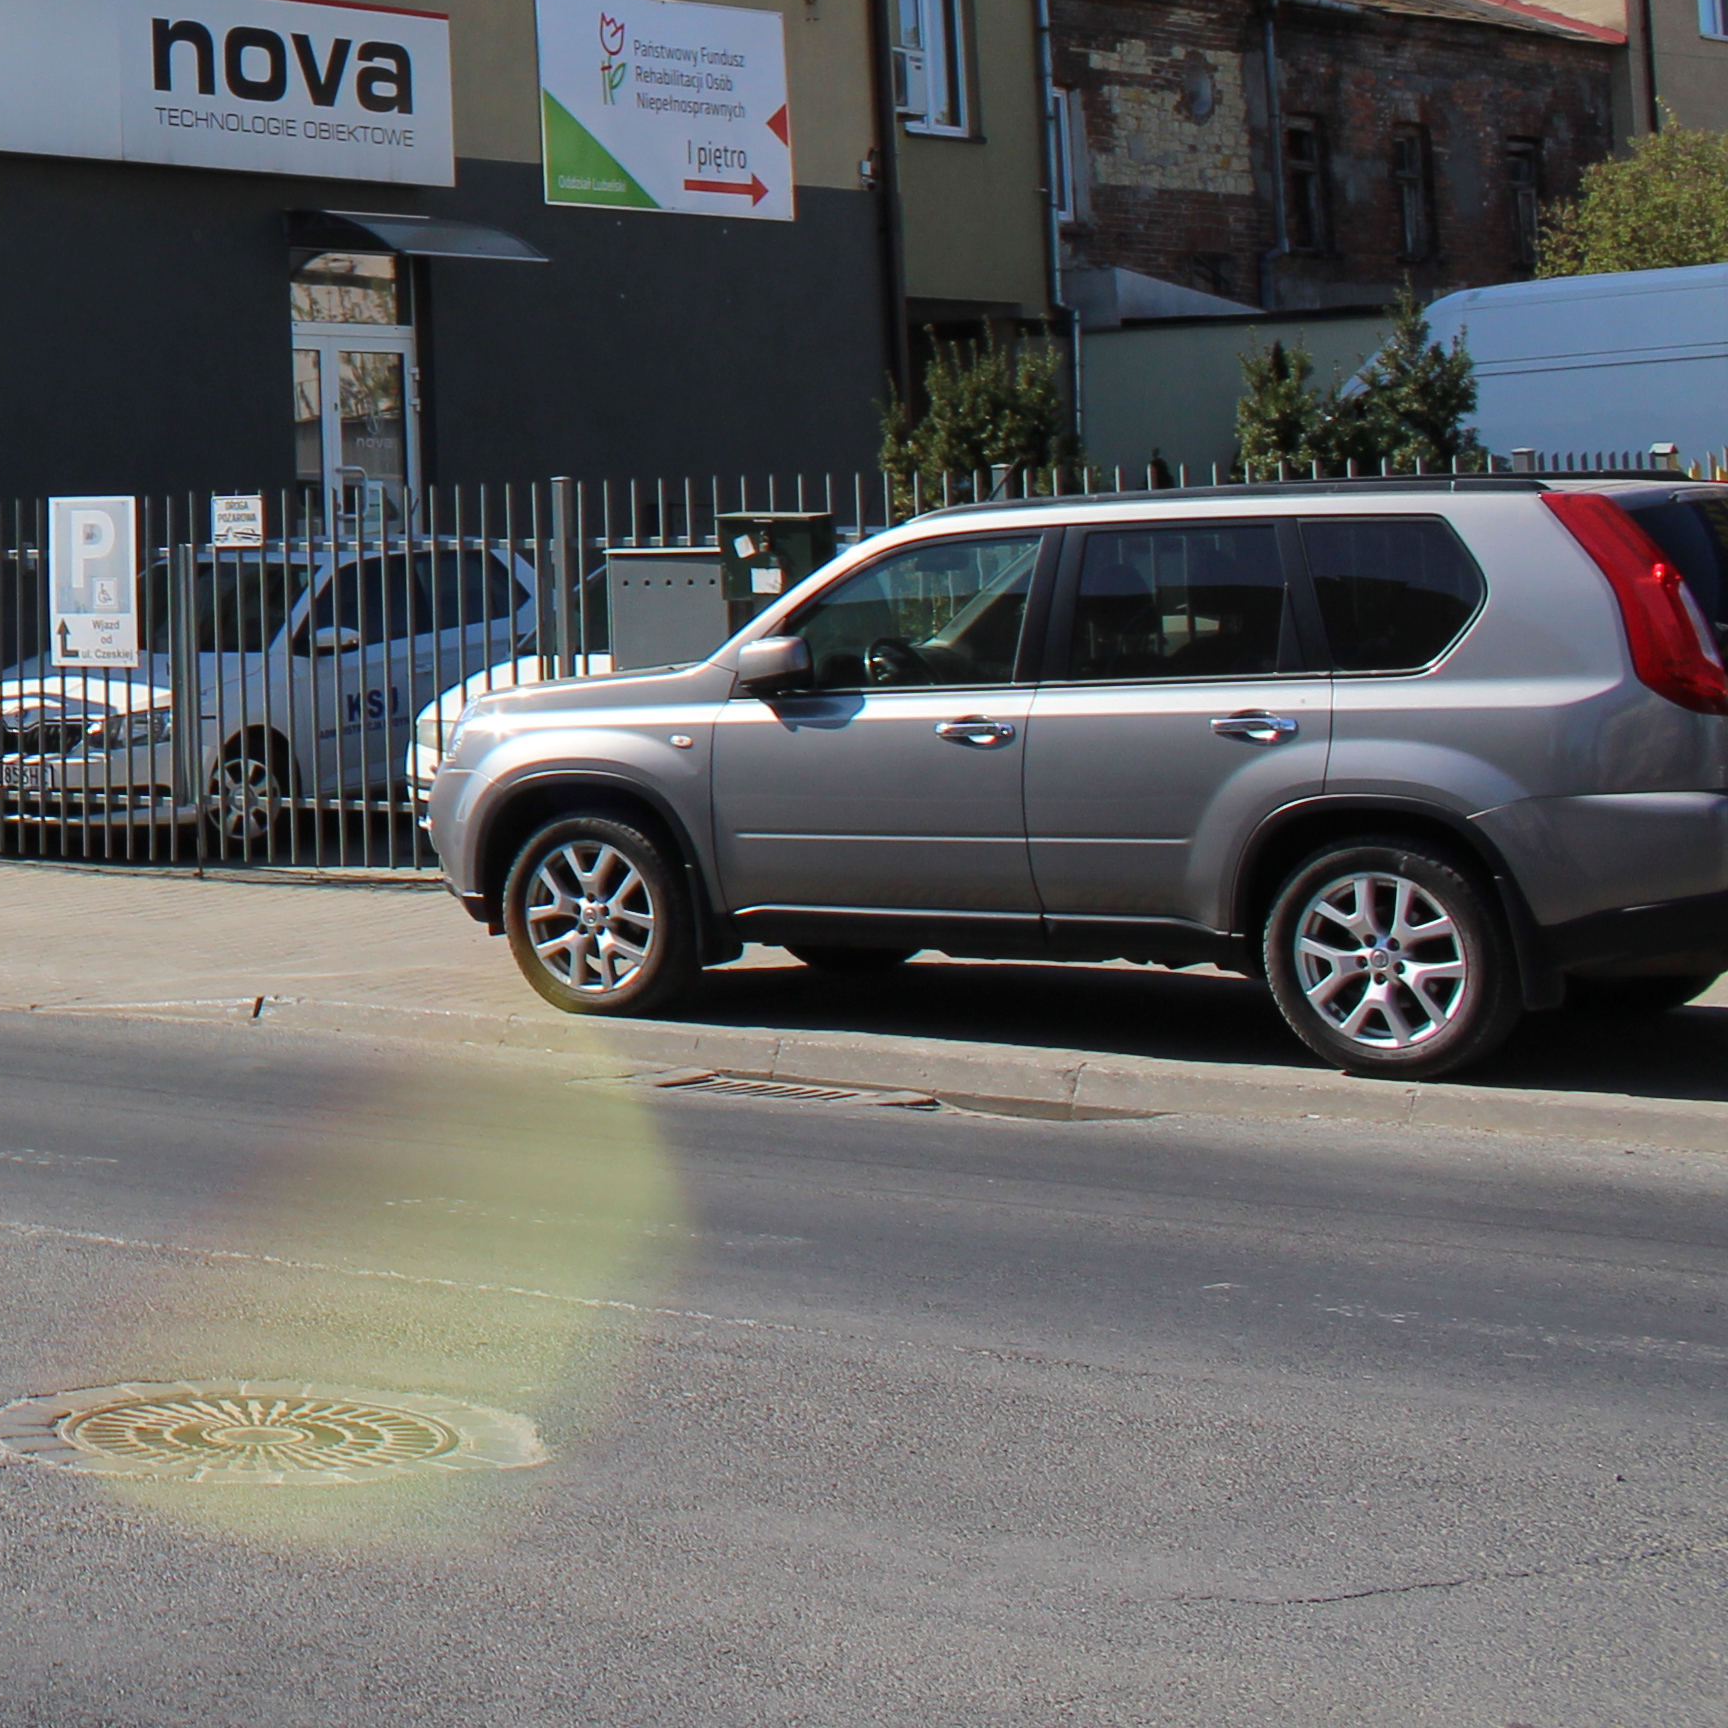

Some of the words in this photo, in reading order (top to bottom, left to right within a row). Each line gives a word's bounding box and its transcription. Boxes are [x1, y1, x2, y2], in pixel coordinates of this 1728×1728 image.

[152, 17, 413, 115] nova
[634, 39, 698, 65] Państwowy
[701, 47, 745, 67] Fundusz
[635, 66, 703, 93] Rehabilitacji
[706, 73, 733, 91] Osób
[636, 92, 746, 121] Niepełnosprawnych
[155, 107, 296, 137] TECHNOLOGIE
[303, 121, 414, 147] OBIEKTOWE
[698, 143, 747, 172] piętro
[225, 501, 248, 510] DROGA
[71, 510, 115, 588] P
[93, 620, 120, 631] Wjazd
[101, 635, 112, 644] od
[95, 648, 133, 660] Czeskiej
